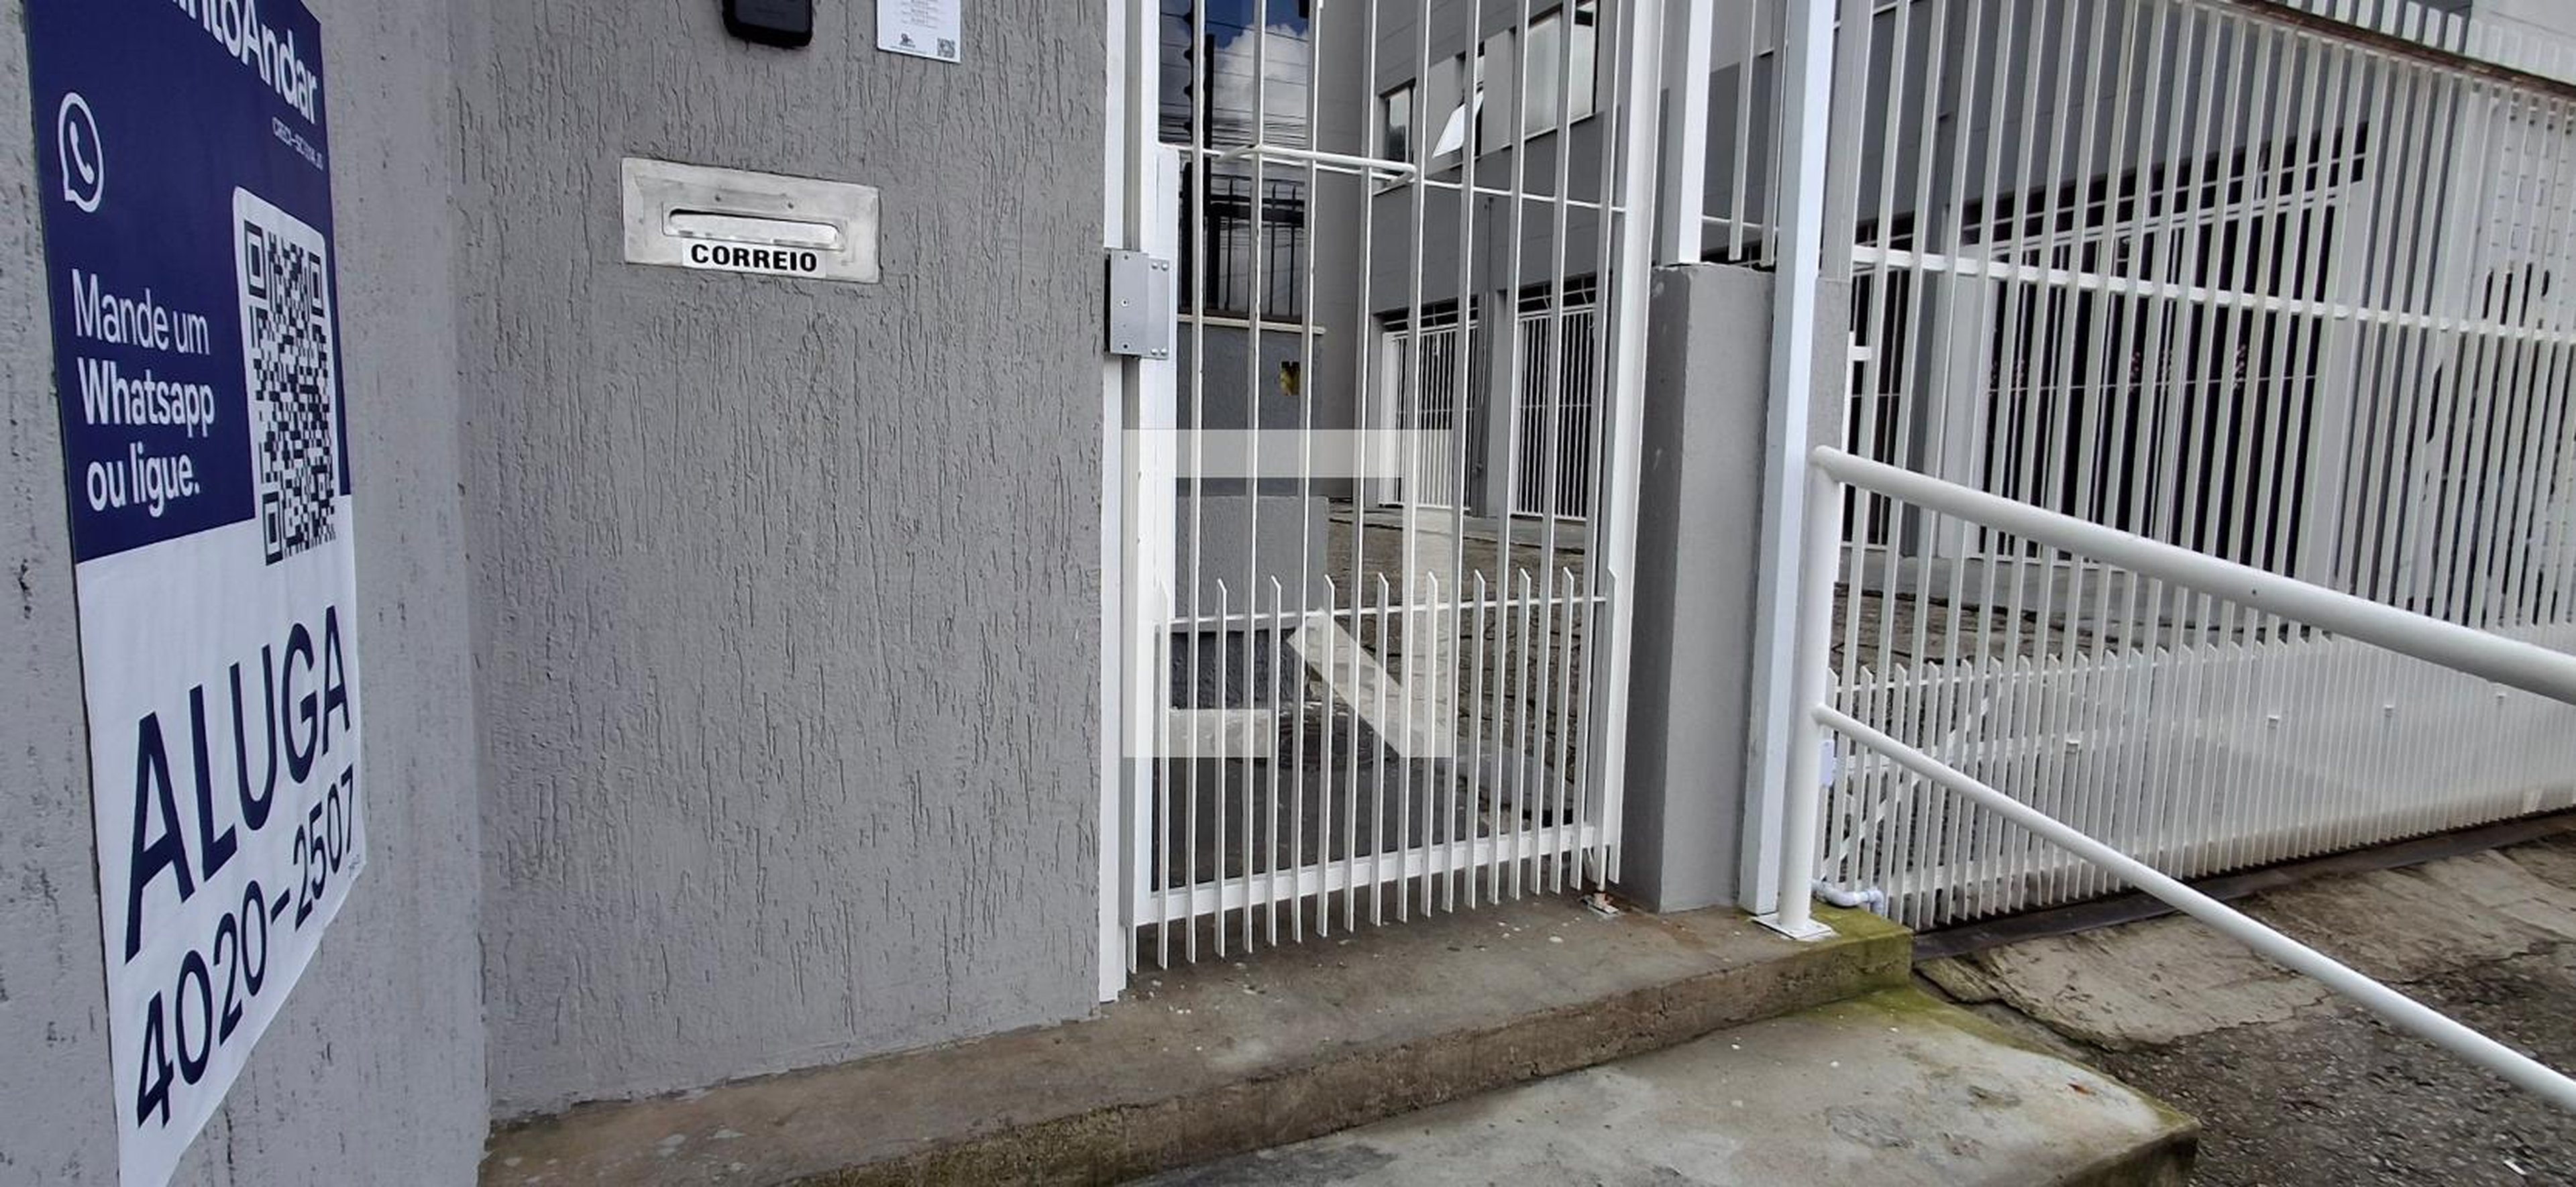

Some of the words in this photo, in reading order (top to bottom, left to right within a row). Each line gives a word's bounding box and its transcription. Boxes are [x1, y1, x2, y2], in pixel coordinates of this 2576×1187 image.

[691, 243, 817, 272] CORREIO
[72, 268, 169, 350] Mande
[174, 310, 210, 355] um
[78, 357, 215, 438] Whatsapp
[87, 459, 127, 512] ou
[130, 441, 201, 518] ligue.
[125, 605, 351, 965] ALUGA
[137, 763, 354, 1129] 4020-2507
